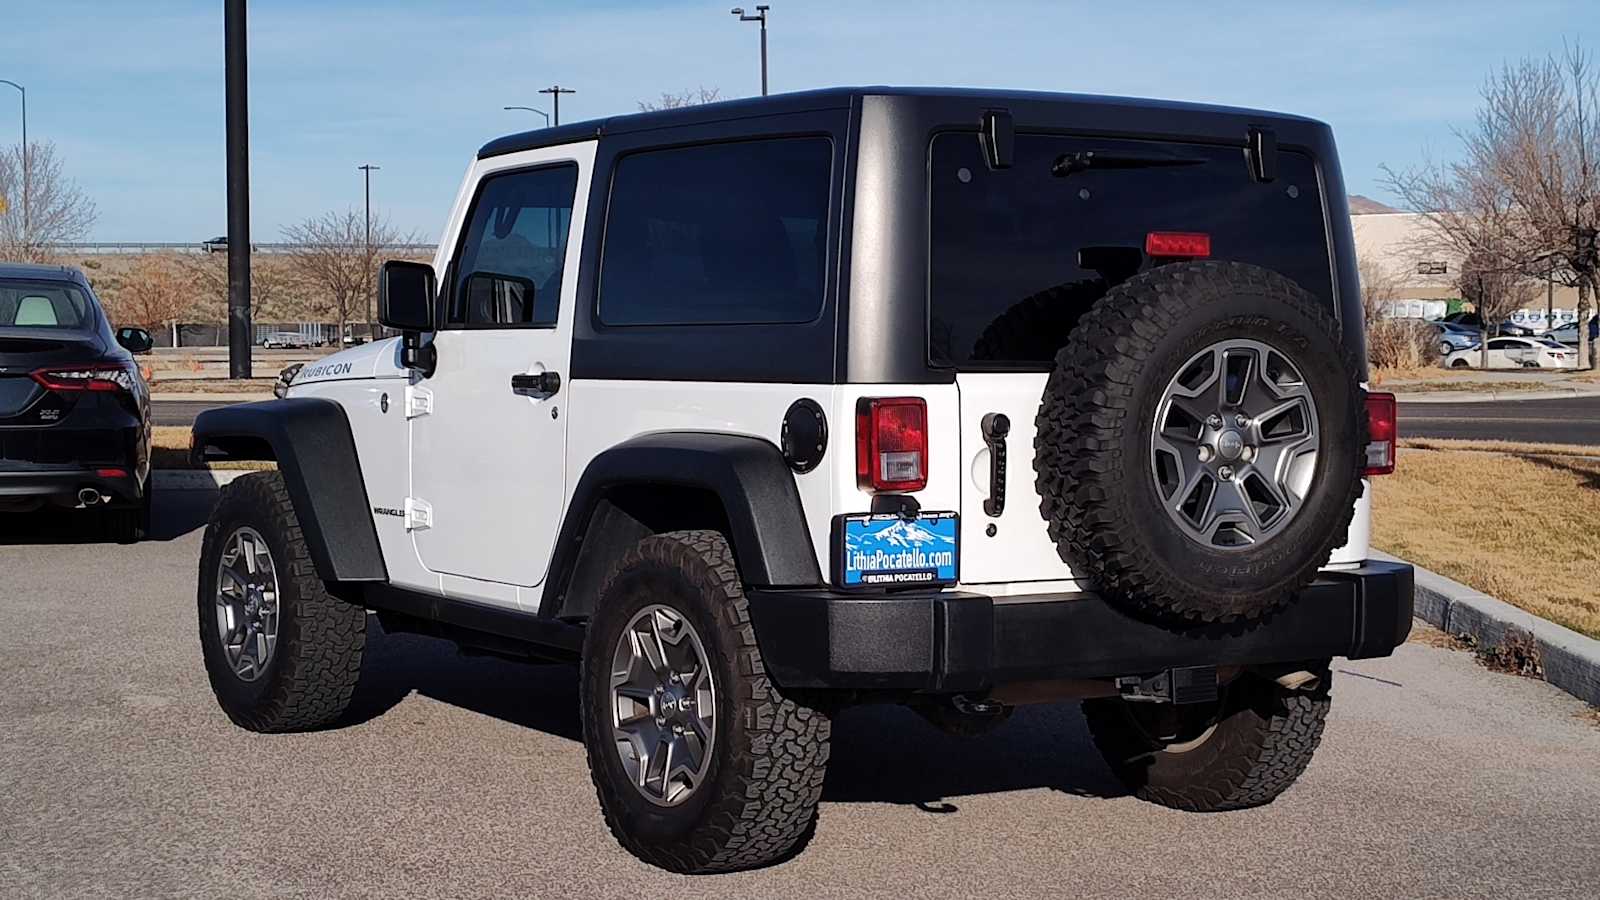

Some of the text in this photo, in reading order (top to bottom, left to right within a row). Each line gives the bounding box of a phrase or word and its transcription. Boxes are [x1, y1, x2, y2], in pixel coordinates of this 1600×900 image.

[303, 362, 353, 379] RUBICON
[373, 507, 405, 517] WRANGLE
[847, 547, 952, 570] LithiaPocatello.com
[872, 572, 932, 583] LITHIA POCATELLO
